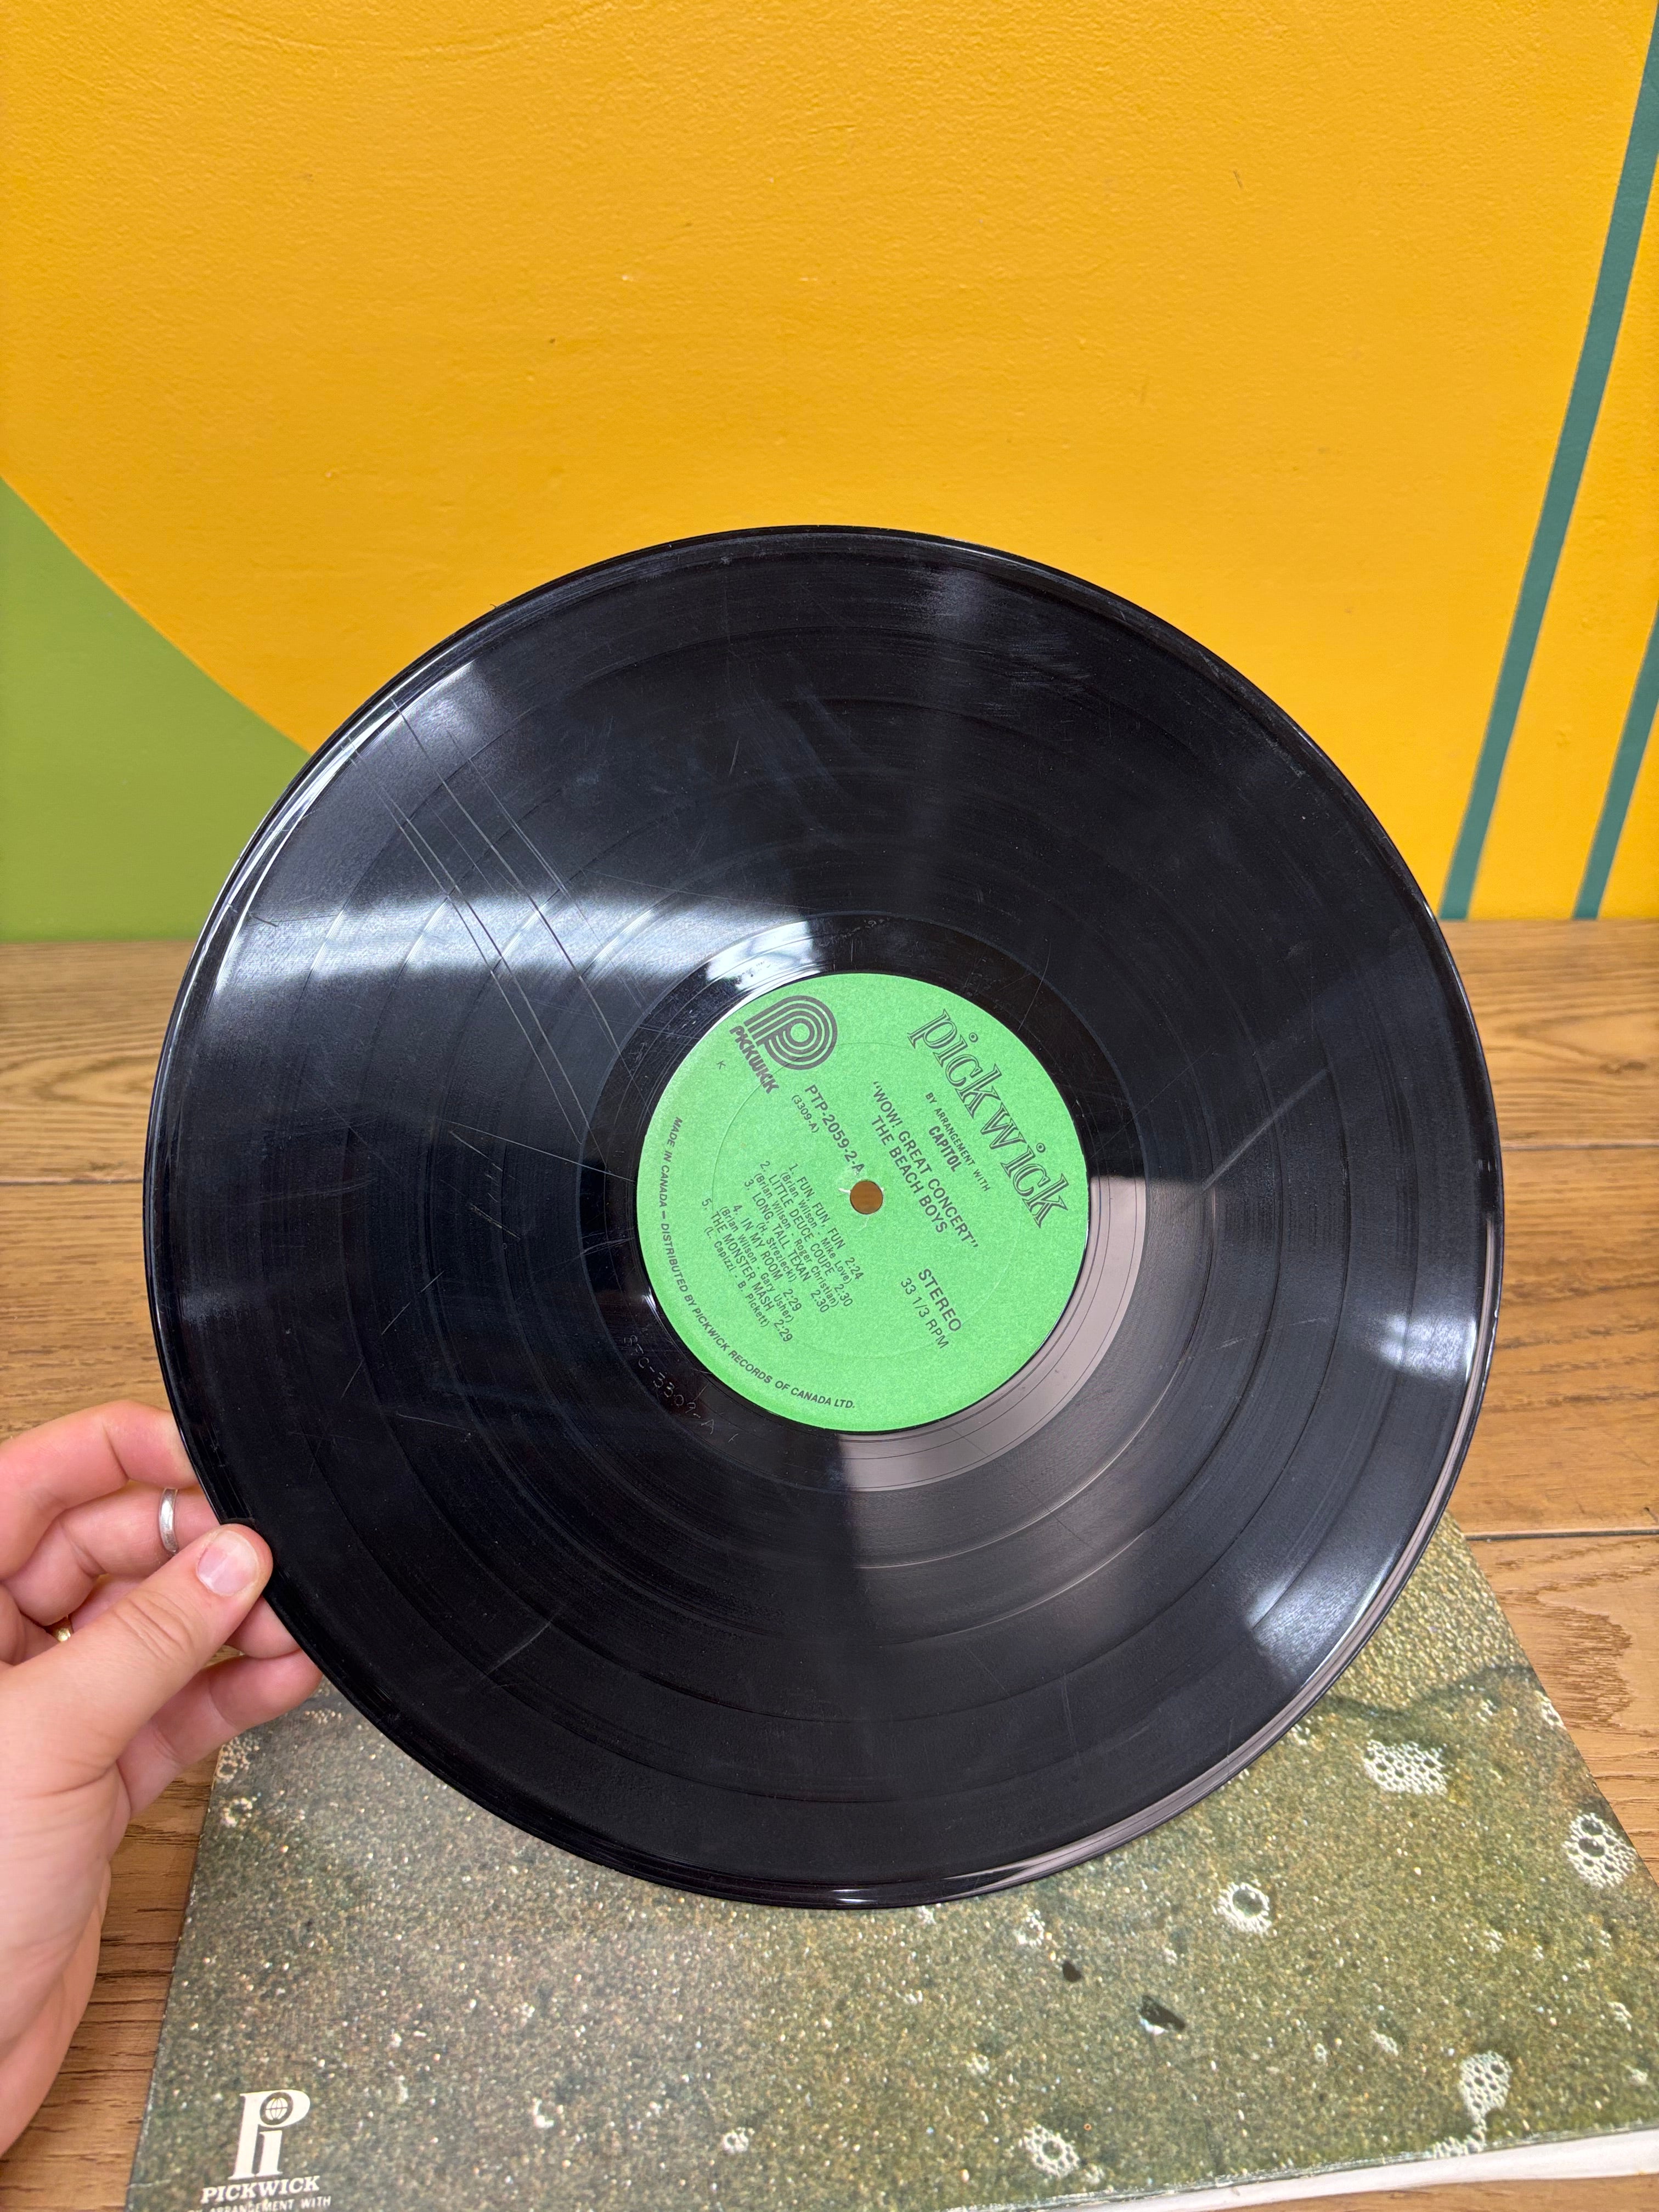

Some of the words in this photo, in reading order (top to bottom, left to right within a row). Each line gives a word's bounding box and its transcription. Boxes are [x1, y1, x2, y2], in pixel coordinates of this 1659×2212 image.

[716, 1060, 725, 1069] K
[729, 1025, 779, 1094] PICKWICK
[667, 1116, 682, 1147] MADE
[791, 1094, 819, 1132] (3309-A)
[804, 1084, 865, 1175] PTP-2059-2-A
[907, 1008, 1069, 1228] pickwick
[925, 1092, 937, 1103] BY
[934, 1108, 975, 1165] ARRANGEMENT
[973, 1169, 990, 1191] WITH
[663, 1150, 672, 1162] IN
[871, 1114, 894, 1146] THE
[889, 1146, 924, 1193] BEACH
[918, 1194, 947, 1233] BOYS
[898, 1130, 932, 1174] GREAT
[928, 1126, 962, 1172] CAPITOL
[659, 1165, 669, 1207] CANADA
[744, 1178, 754, 1190] 3.
[752, 1192, 774, 1223] LONG,
[772, 1223, 789, 1249] TALL
[787, 1249, 811, 1282] TEXAN
[810, 1289, 830, 1312] 2:30
[753, 1173, 772, 1198] (Brian
[771, 1200, 791, 1229] Wilson
[794, 1238, 812, 1262] Roger
[811, 1266, 839, 1307] Christian)
[755, 1222, 768, 1235] (H.
[760, 1160, 770, 1172] 2.
[768, 1174, 793, 1207] LITTLE
[788, 1208, 814, 1242] DEUCE
[810, 1243, 834, 1276] COUPE
[834, 1284, 853, 1306] 2:30
[780, 1172, 799, 1197] (Brian
[798, 1199, 817, 1228] Wilson
[820, 1237, 836, 1259] Mike
[834, 1260, 851, 1284] Love)
[788, 1163, 798, 1174] 1.
[796, 1176, 815, 1201] FUN,
[811, 1201, 830, 1227] FUN,
[827, 1227, 845, 1249] FUN
[844, 1257, 864, 1279] 2:24
[661, 1223, 688, 1291] DISTRIBUTED
[702, 1198, 712, 1209] 5.
[710, 1211, 727, 1233] THE
[722, 1233, 755, 1281] MONSTER
[751, 1282, 774, 1311] MASH
[774, 1319, 793, 1341] 2:29
[704, 1226, 713, 1238] (L.
[714, 1240, 736, 1271] Capizzi
[737, 1280, 746, 1291] B.
[744, 1293, 770, 1327] Pickett)
[719, 1206, 738, 1232] (Brian
[737, 1234, 757, 1263] Wilson
[760, 1272, 775, 1291] Gary
[774, 1294, 794, 1322] Usher)
[733, 1205, 742, 1216] 4.
[740, 1217, 754, 1231] IN
[749, 1232, 765, 1248] MY
[760, 1250, 783, 1280] ROOM
[782, 1288, 802, 1311] 2:29
[684, 1294, 697, 1305] BY
[692, 1307, 730, 1351] PICKWICK
[900, 1277, 916, 1295] 33
[912, 1296, 929, 1317] 1/3
[925, 1318, 949, 1348] RPM
[918, 1268, 961, 1331] STEREO
[728, 1350, 772, 1383] RECORDS
[775, 1380, 790, 1390] OF
[791, 1387, 831, 1405] CANADA
[833, 1398, 855, 1408] LTD.
[200, 2175, 320, 2204] PICKWICK
[301, 2196, 331, 2209] WITH
